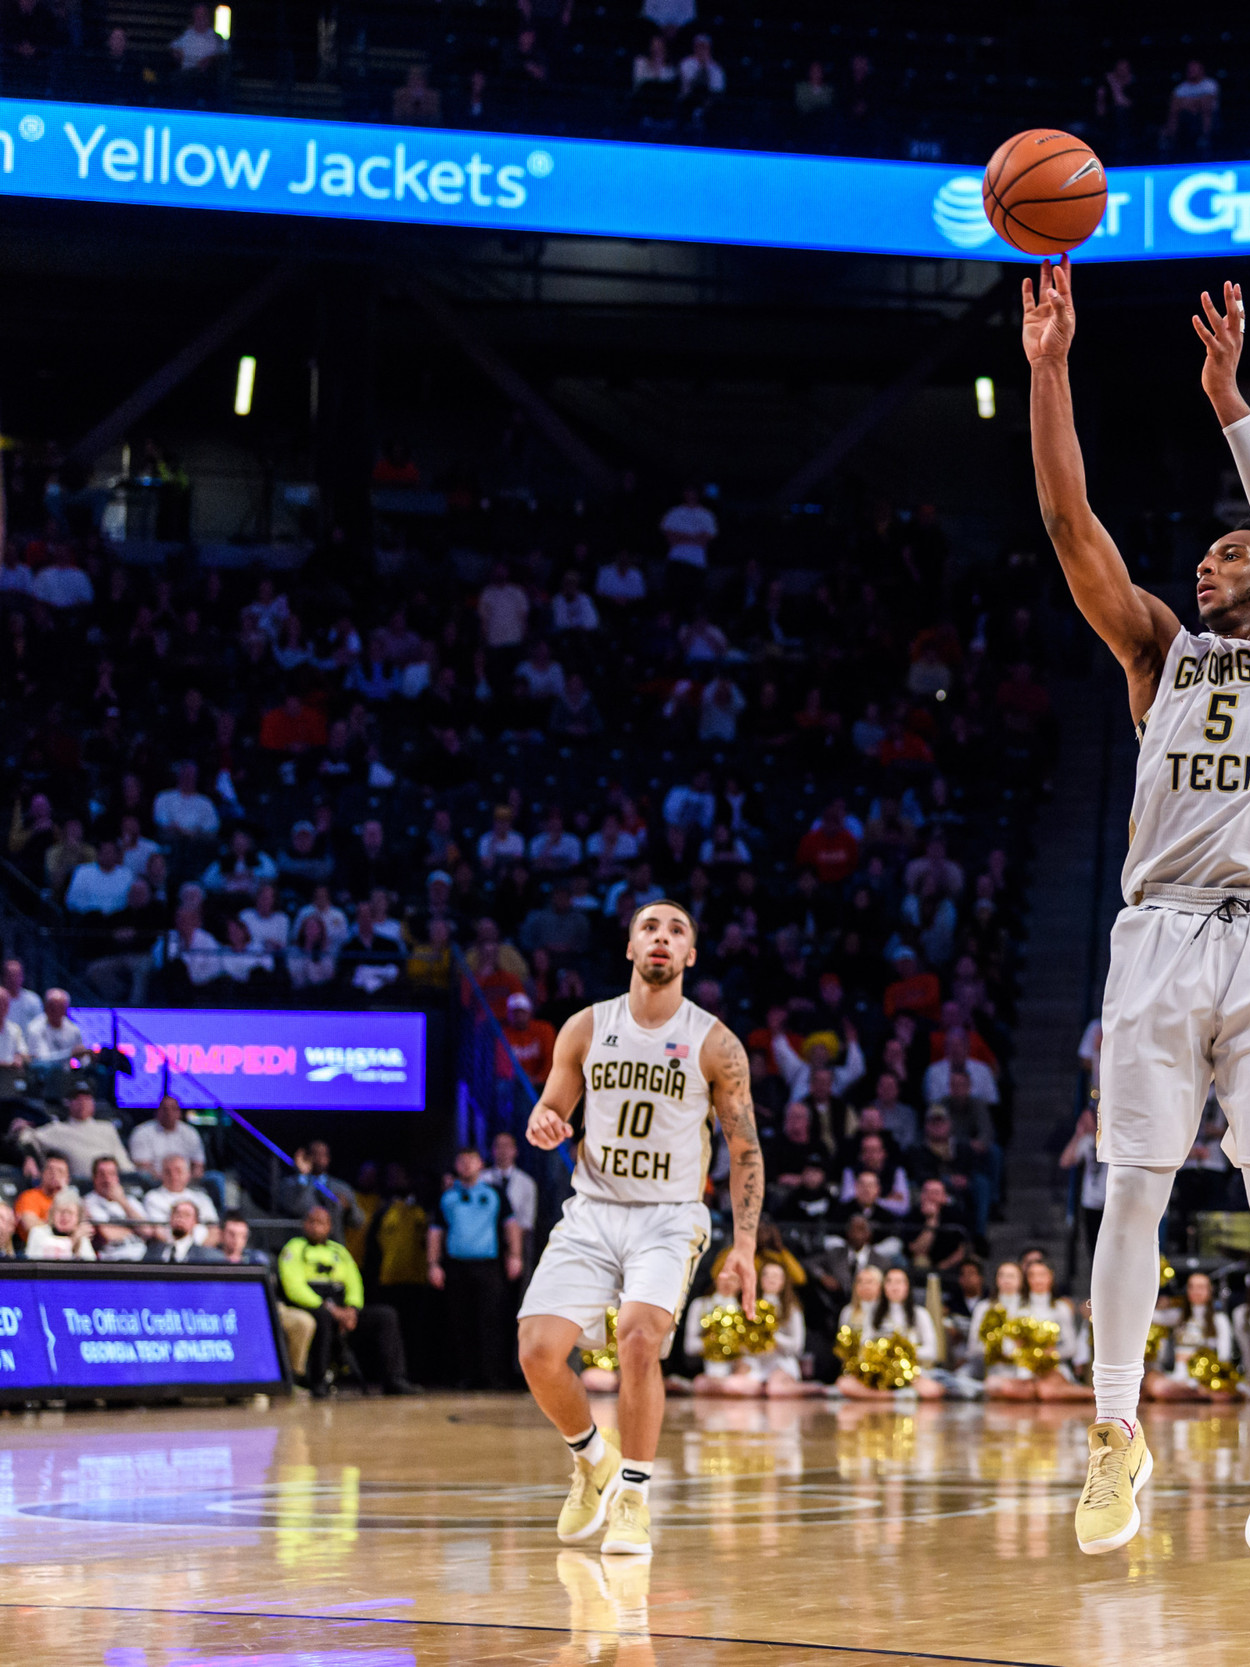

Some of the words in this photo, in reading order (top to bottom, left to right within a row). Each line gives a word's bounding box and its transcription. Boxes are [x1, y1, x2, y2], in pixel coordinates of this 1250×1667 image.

[63, 121, 271, 190] Yellow
[1203, 691, 1240, 743] 5
[591, 1061, 687, 1102] GEORGIA
[617, 1100, 654, 1139] 10
[601, 1145, 671, 1181] TECH
[62, 1308, 93, 1335] The
[141, 1308, 184, 1335] Credit
